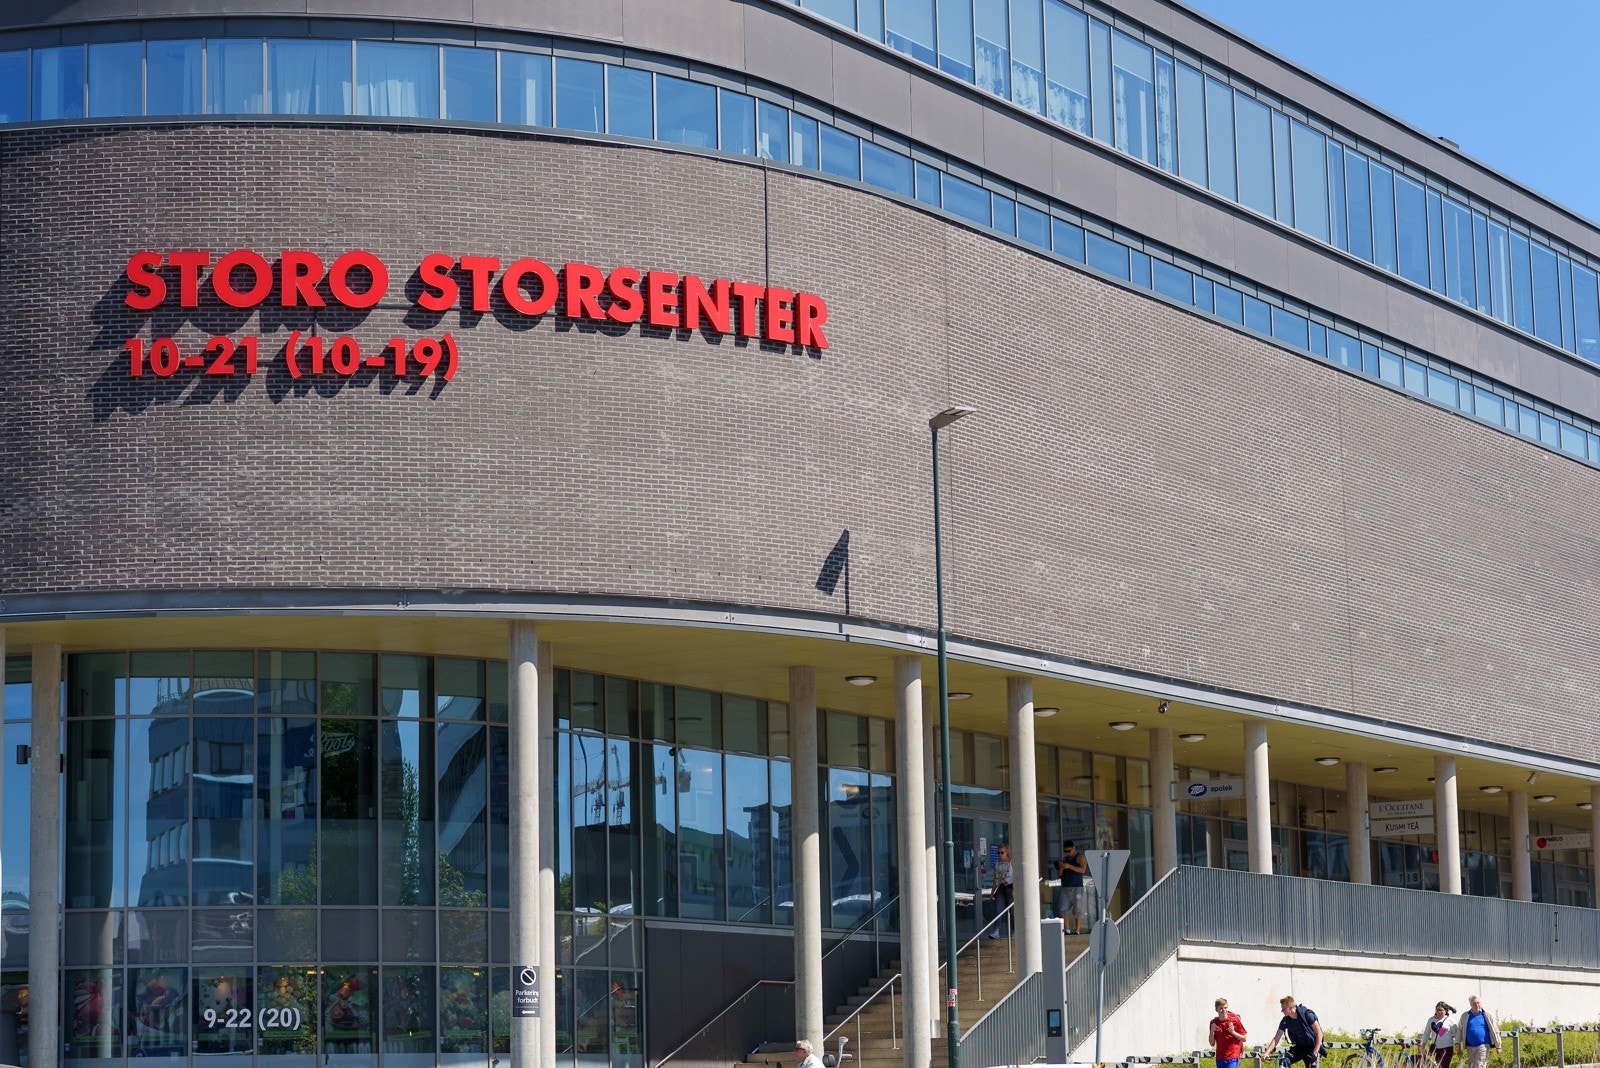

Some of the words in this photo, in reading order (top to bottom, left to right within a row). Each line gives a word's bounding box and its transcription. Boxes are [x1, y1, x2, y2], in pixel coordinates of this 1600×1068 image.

[124, 249, 390, 310] STORO
[417, 252, 830, 350] STORSENTER
[123, 335, 259, 377] 10-21
[285, 329, 460, 382] (10-19)
[1385, 822, 1406, 832] KUSMI
[1407, 822, 1419, 830] TEA
[203, 1008, 252, 1029] 9-22
[258, 1007, 301, 1031] (20)
